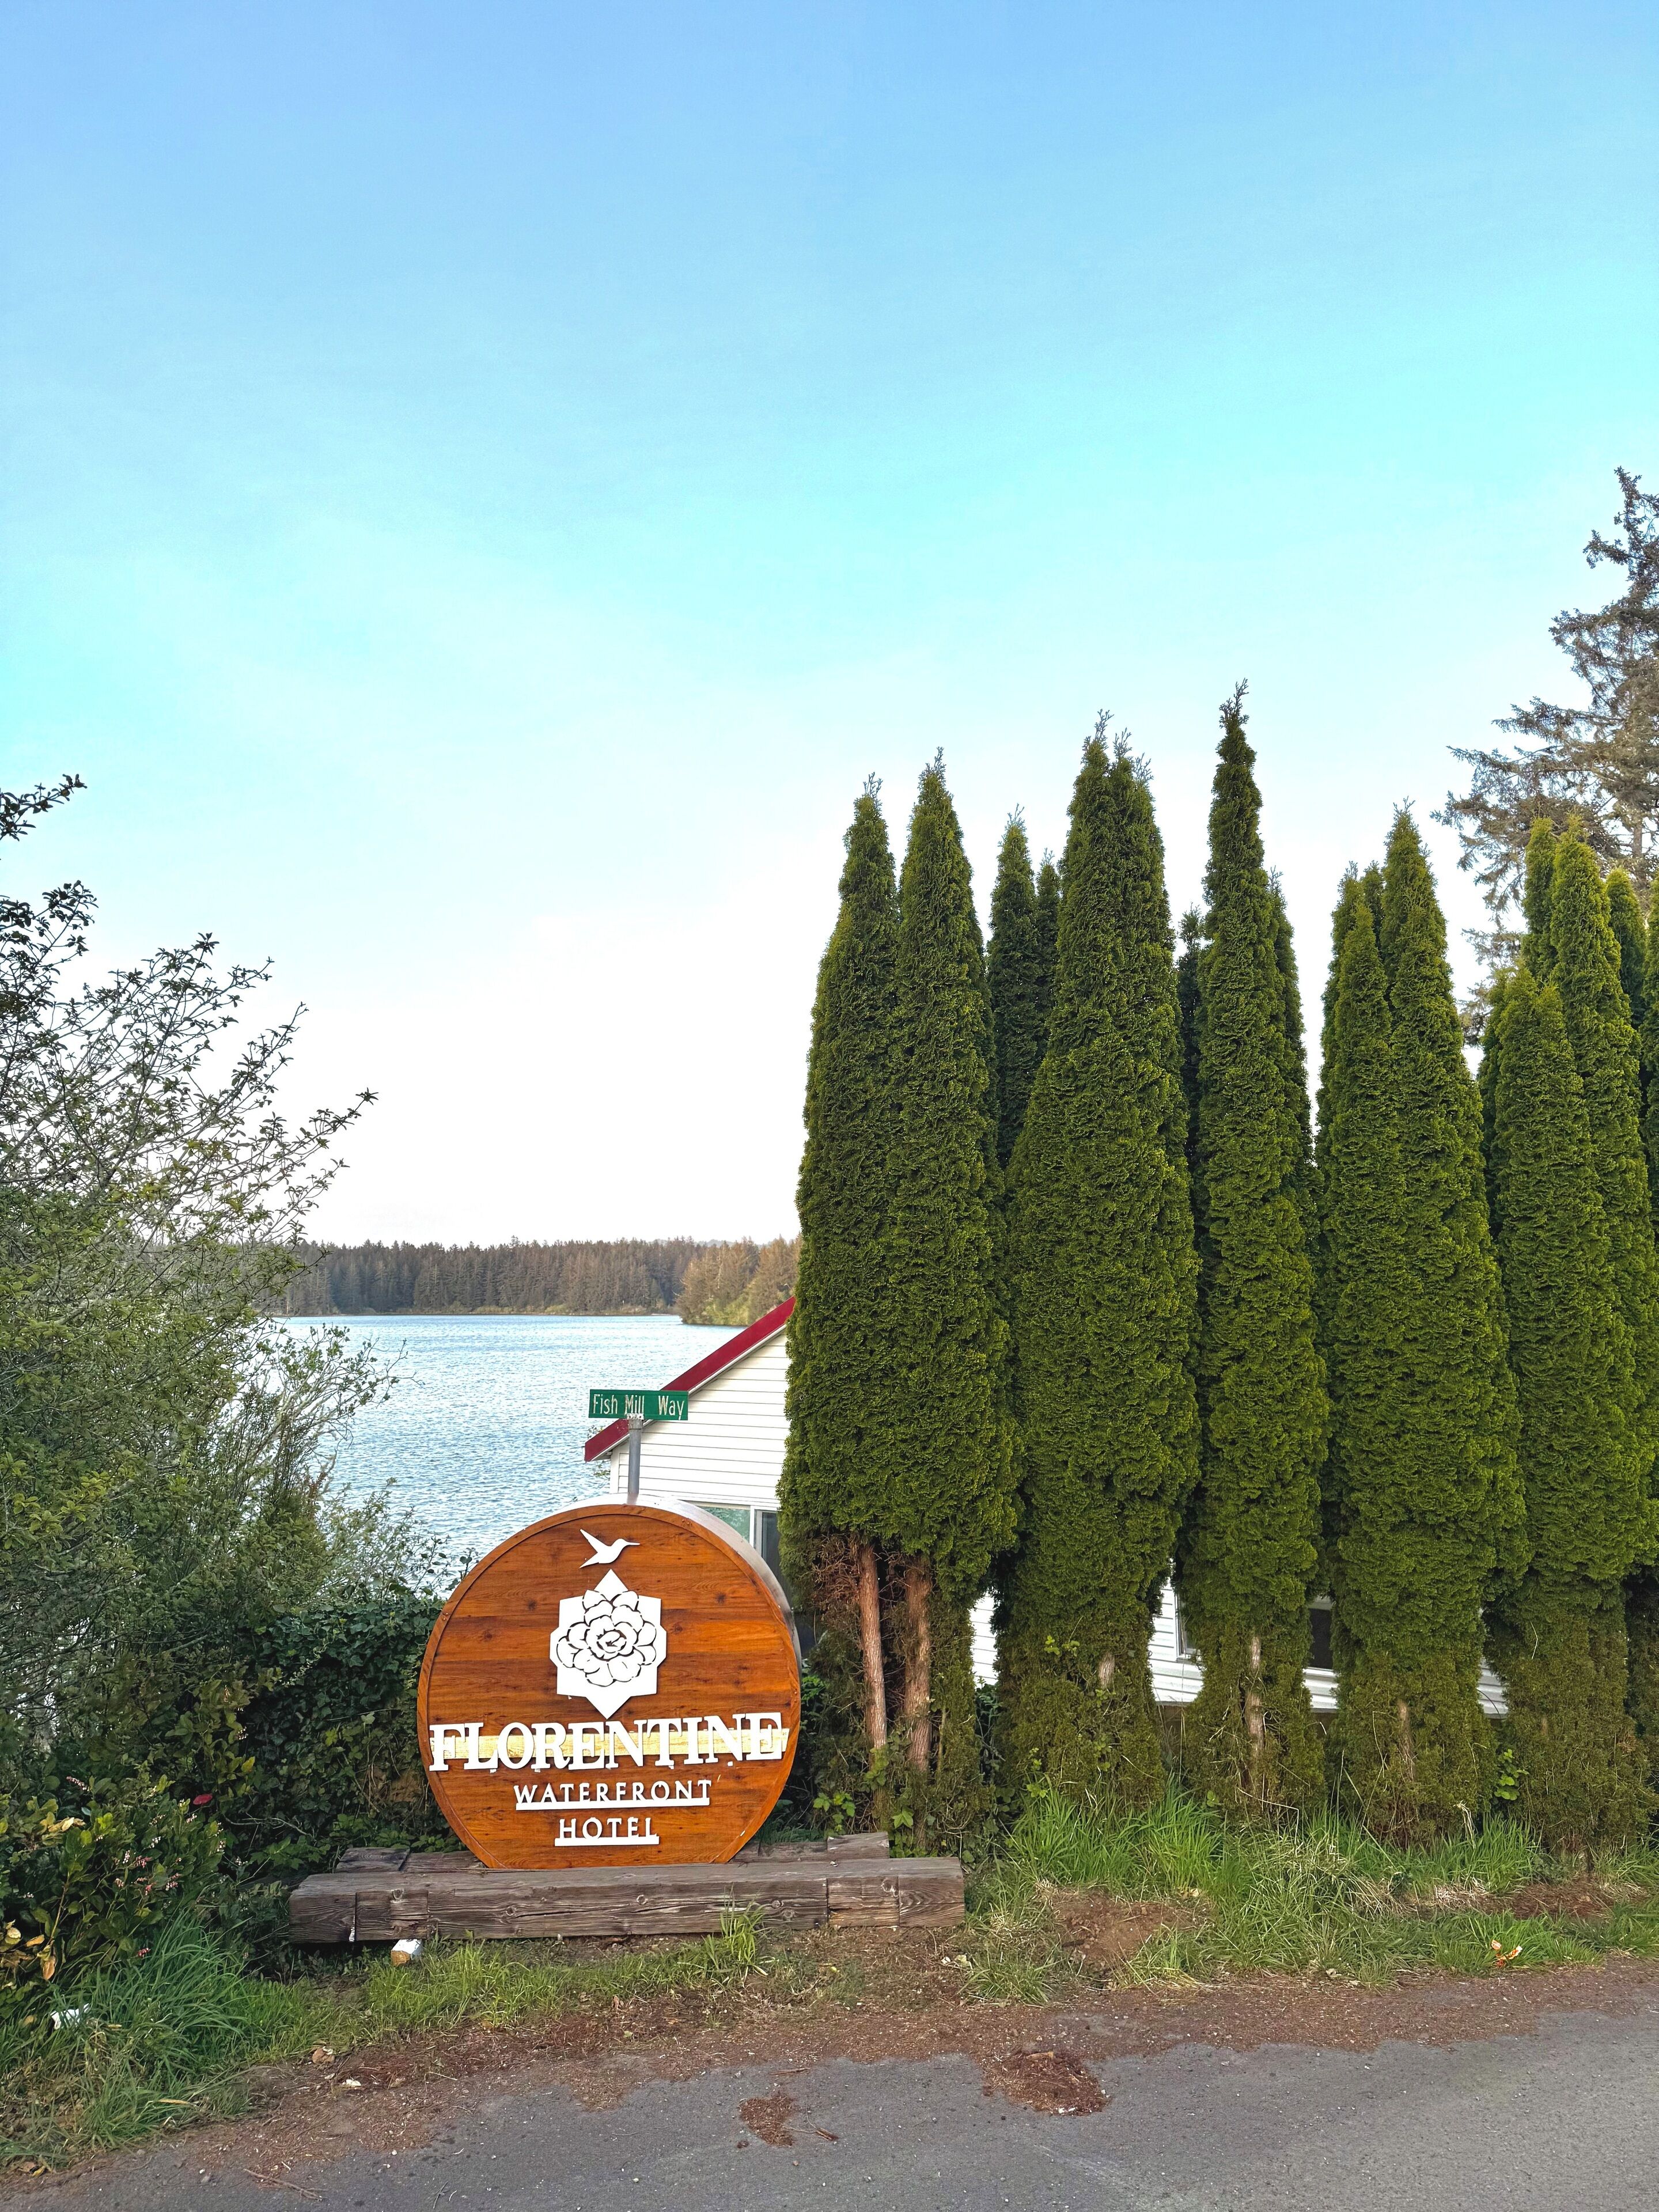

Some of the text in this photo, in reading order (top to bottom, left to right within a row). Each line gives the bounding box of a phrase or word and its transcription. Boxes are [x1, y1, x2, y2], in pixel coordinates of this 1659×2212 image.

[593, 1394, 684, 1420] Fish Mill Way
[429, 1712, 782, 1771] FLORENTINE
[513, 1779, 711, 1805] WATERFRONT
[558, 1817, 659, 1839] HOTEL
